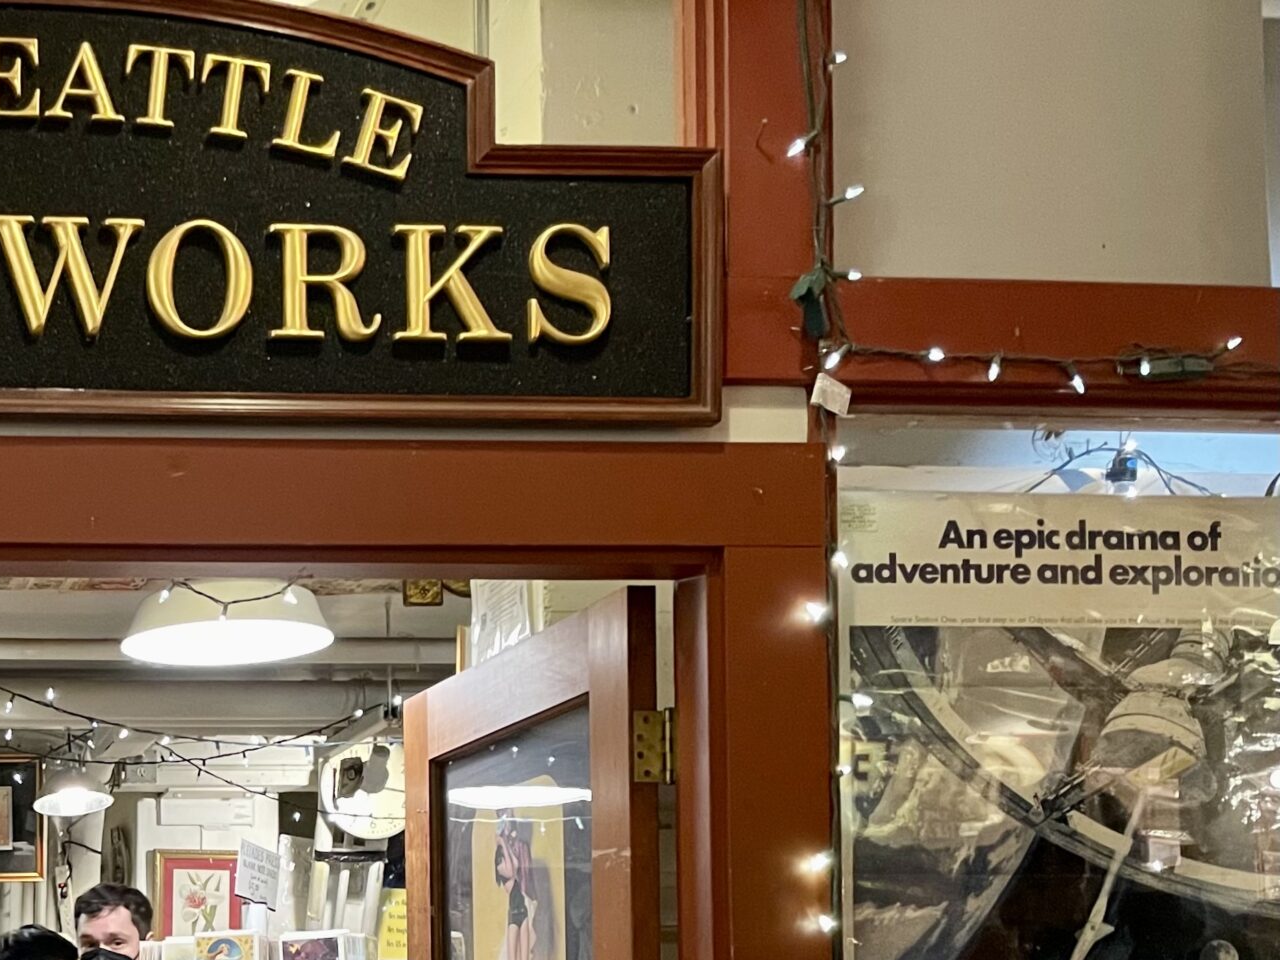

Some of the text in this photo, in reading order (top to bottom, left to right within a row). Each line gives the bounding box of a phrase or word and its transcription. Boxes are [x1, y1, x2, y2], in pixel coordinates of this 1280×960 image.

[938, 518, 1222, 558] An epic drama of
[851, 553, 1031, 584] adventure
[1037, 554, 1103, 586] and
